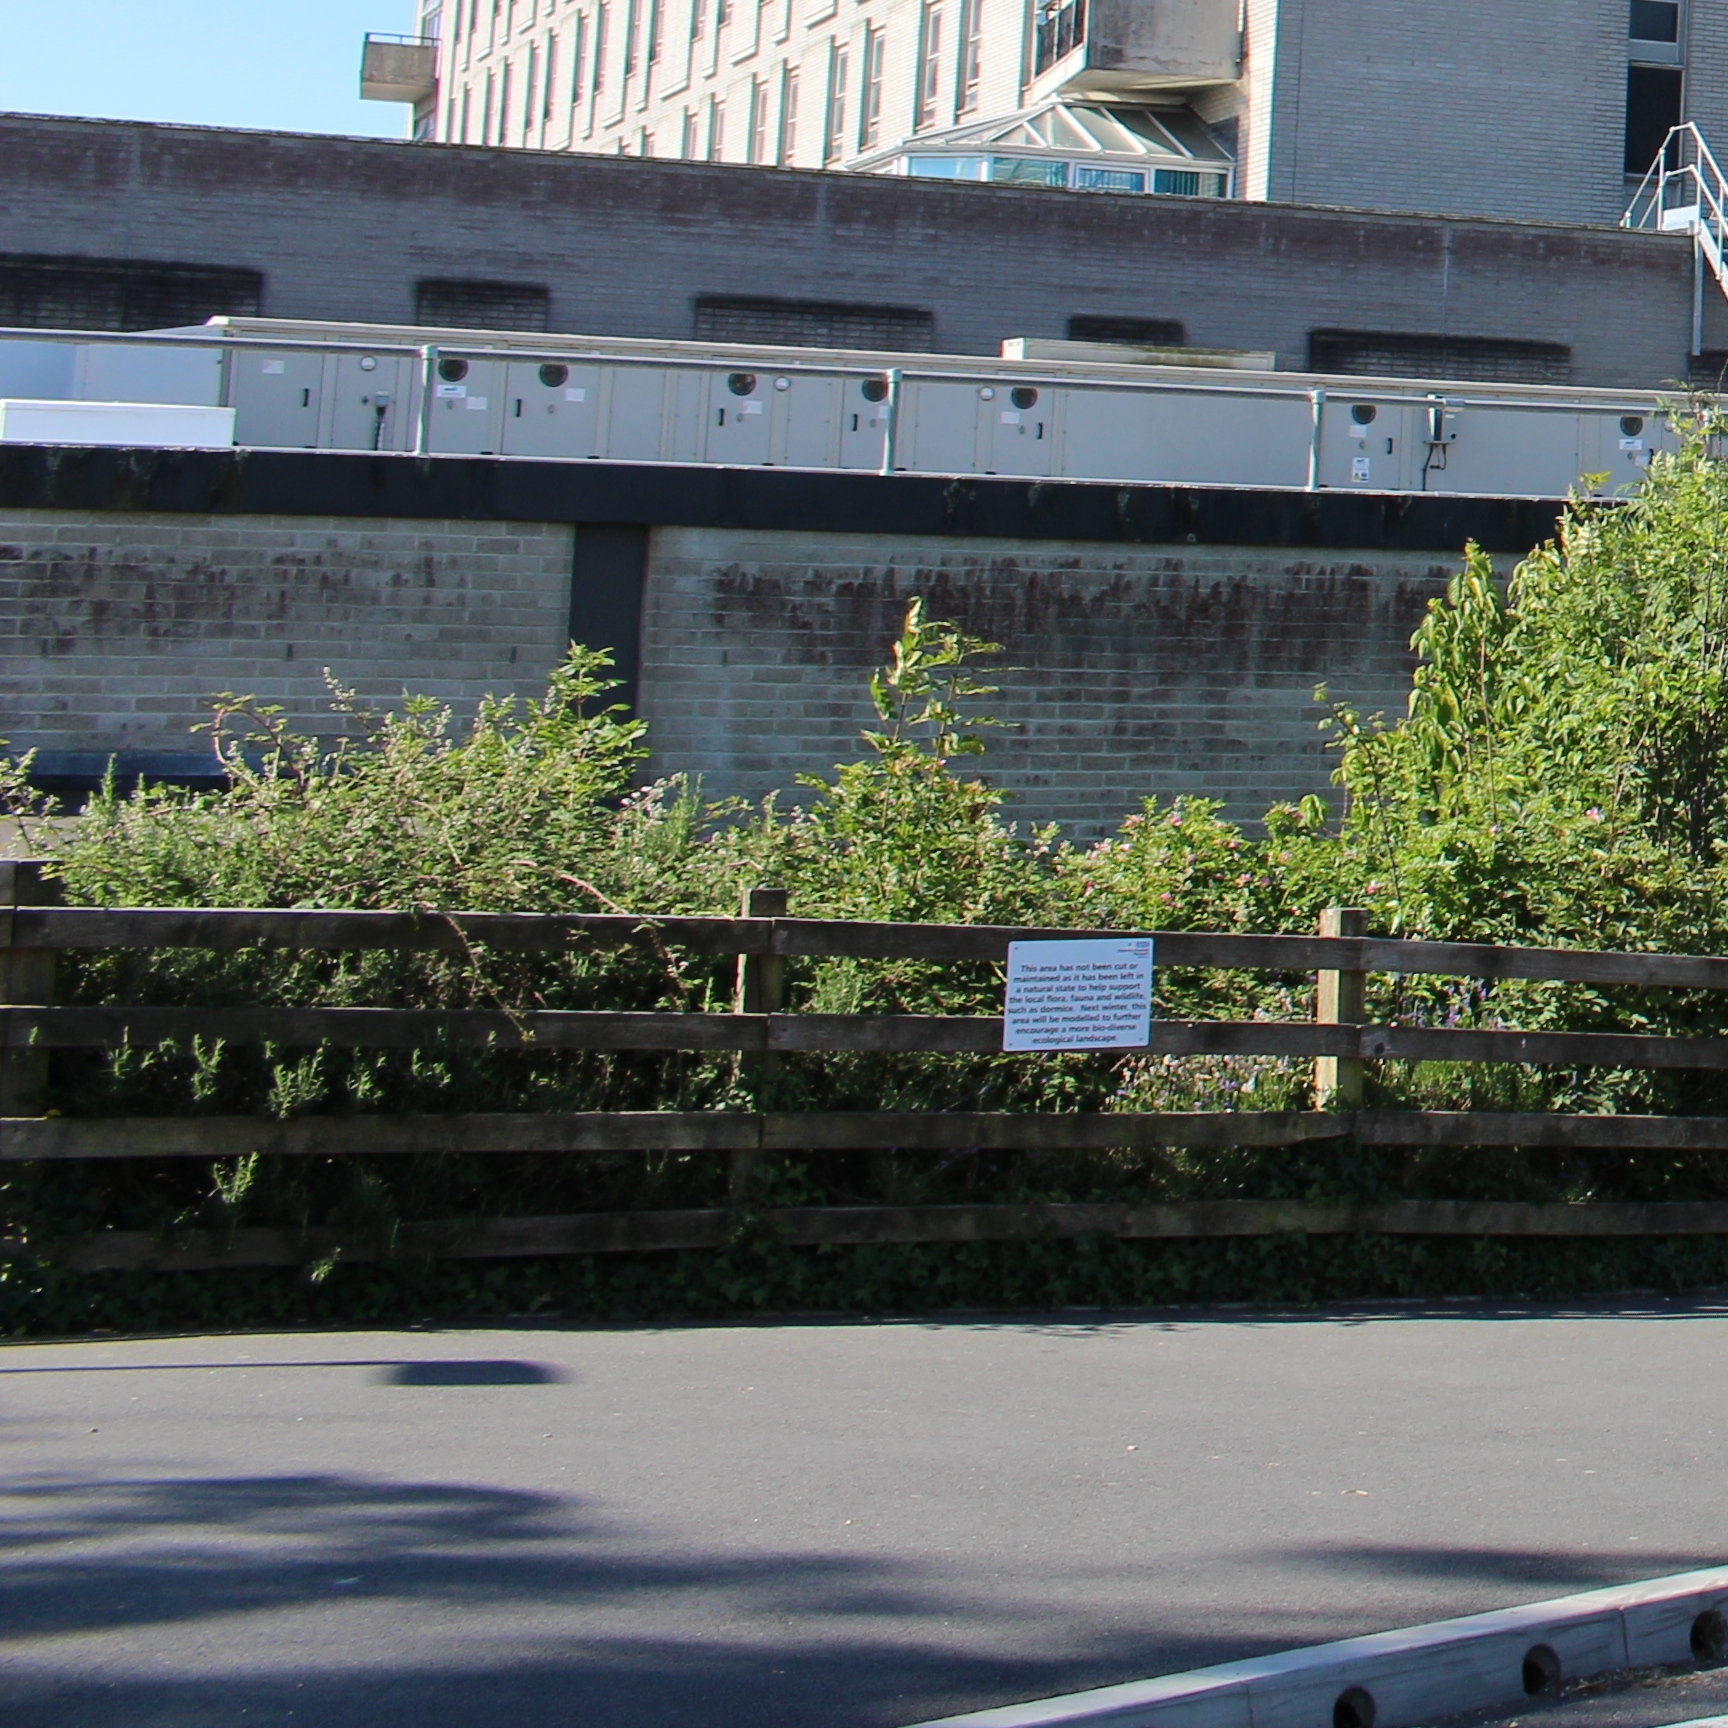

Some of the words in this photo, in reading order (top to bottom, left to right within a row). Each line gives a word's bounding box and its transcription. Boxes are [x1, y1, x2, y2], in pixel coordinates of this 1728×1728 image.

[1090, 984, 1107, 992] help
[1110, 983, 1140, 991] support
[1033, 1036, 1073, 1044] ecological
